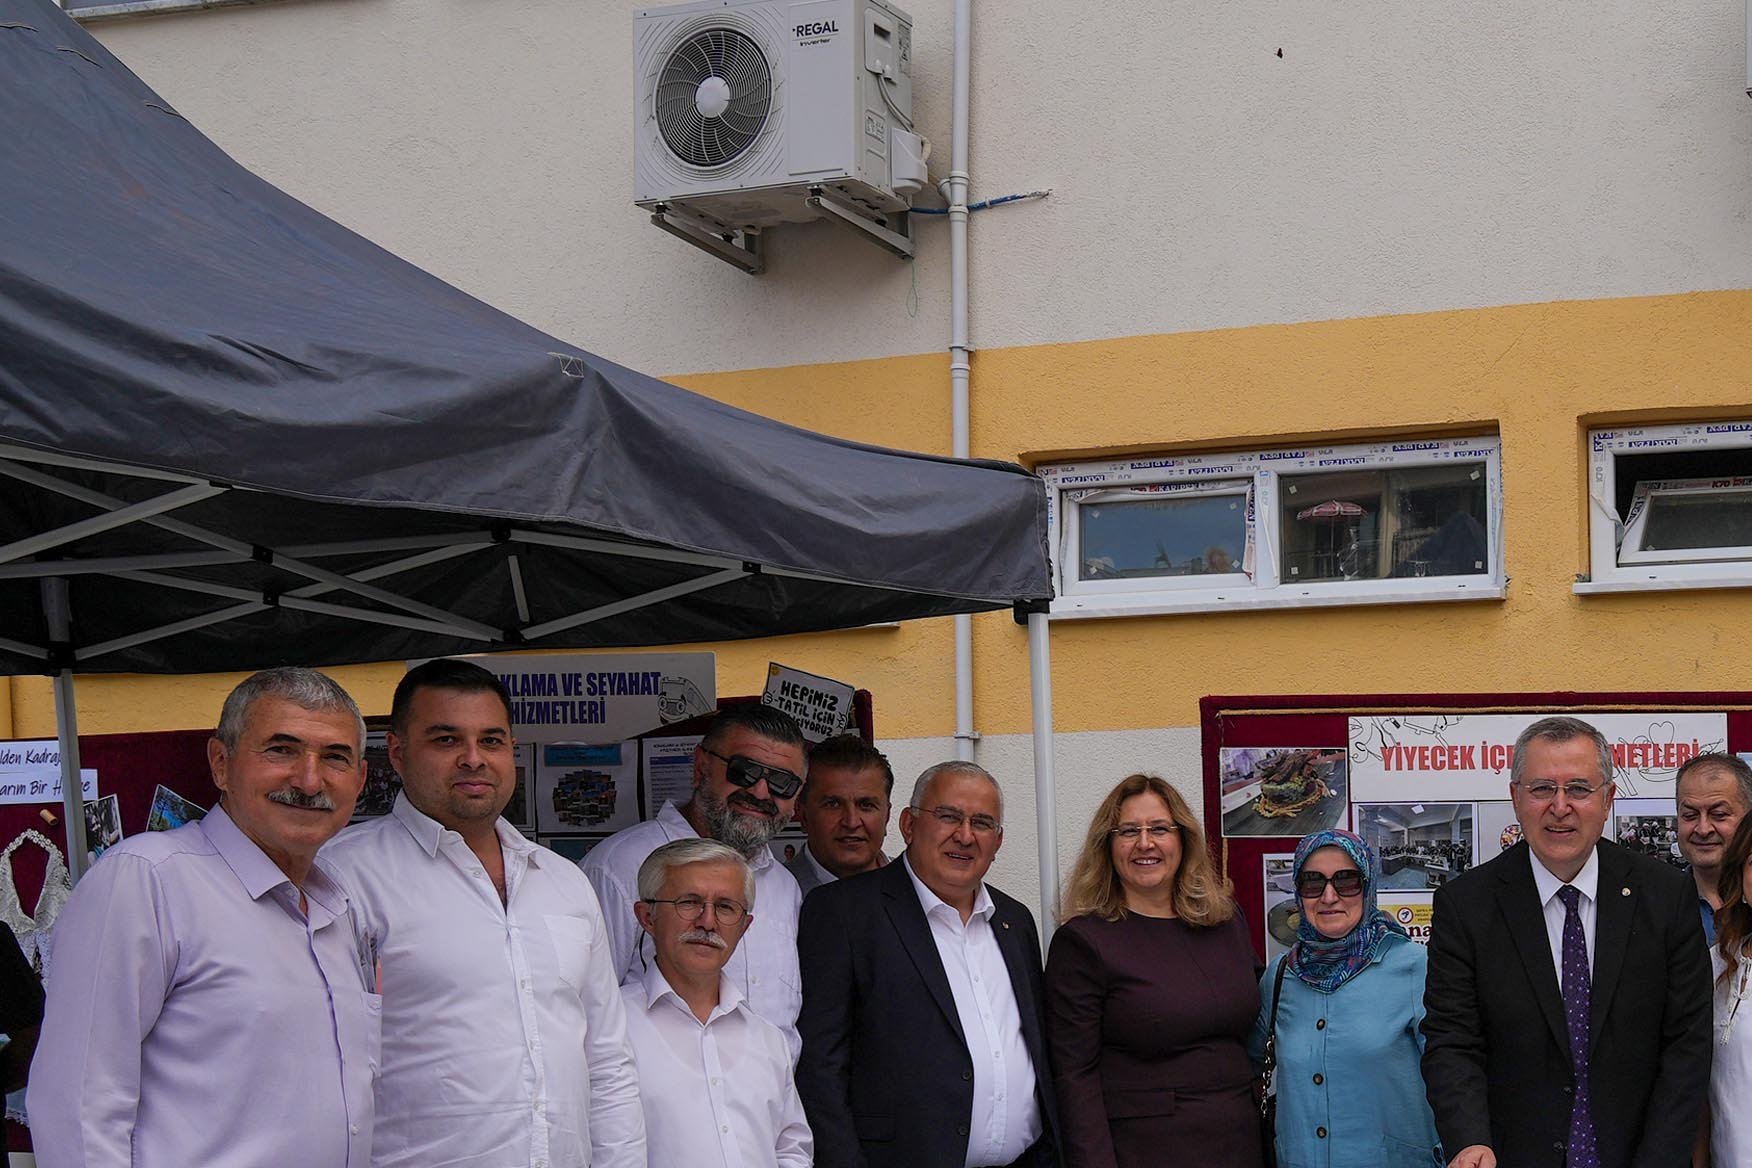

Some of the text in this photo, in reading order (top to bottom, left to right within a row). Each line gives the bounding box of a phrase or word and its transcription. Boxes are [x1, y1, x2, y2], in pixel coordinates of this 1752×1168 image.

[795, 20, 839, 37] REGAL
[561, 673, 584, 697] VE
[588, 671, 662, 696] SEYAHAT
[1380, 744, 1476, 771] YİYECEK
[30, 780, 48, 796] Bir
